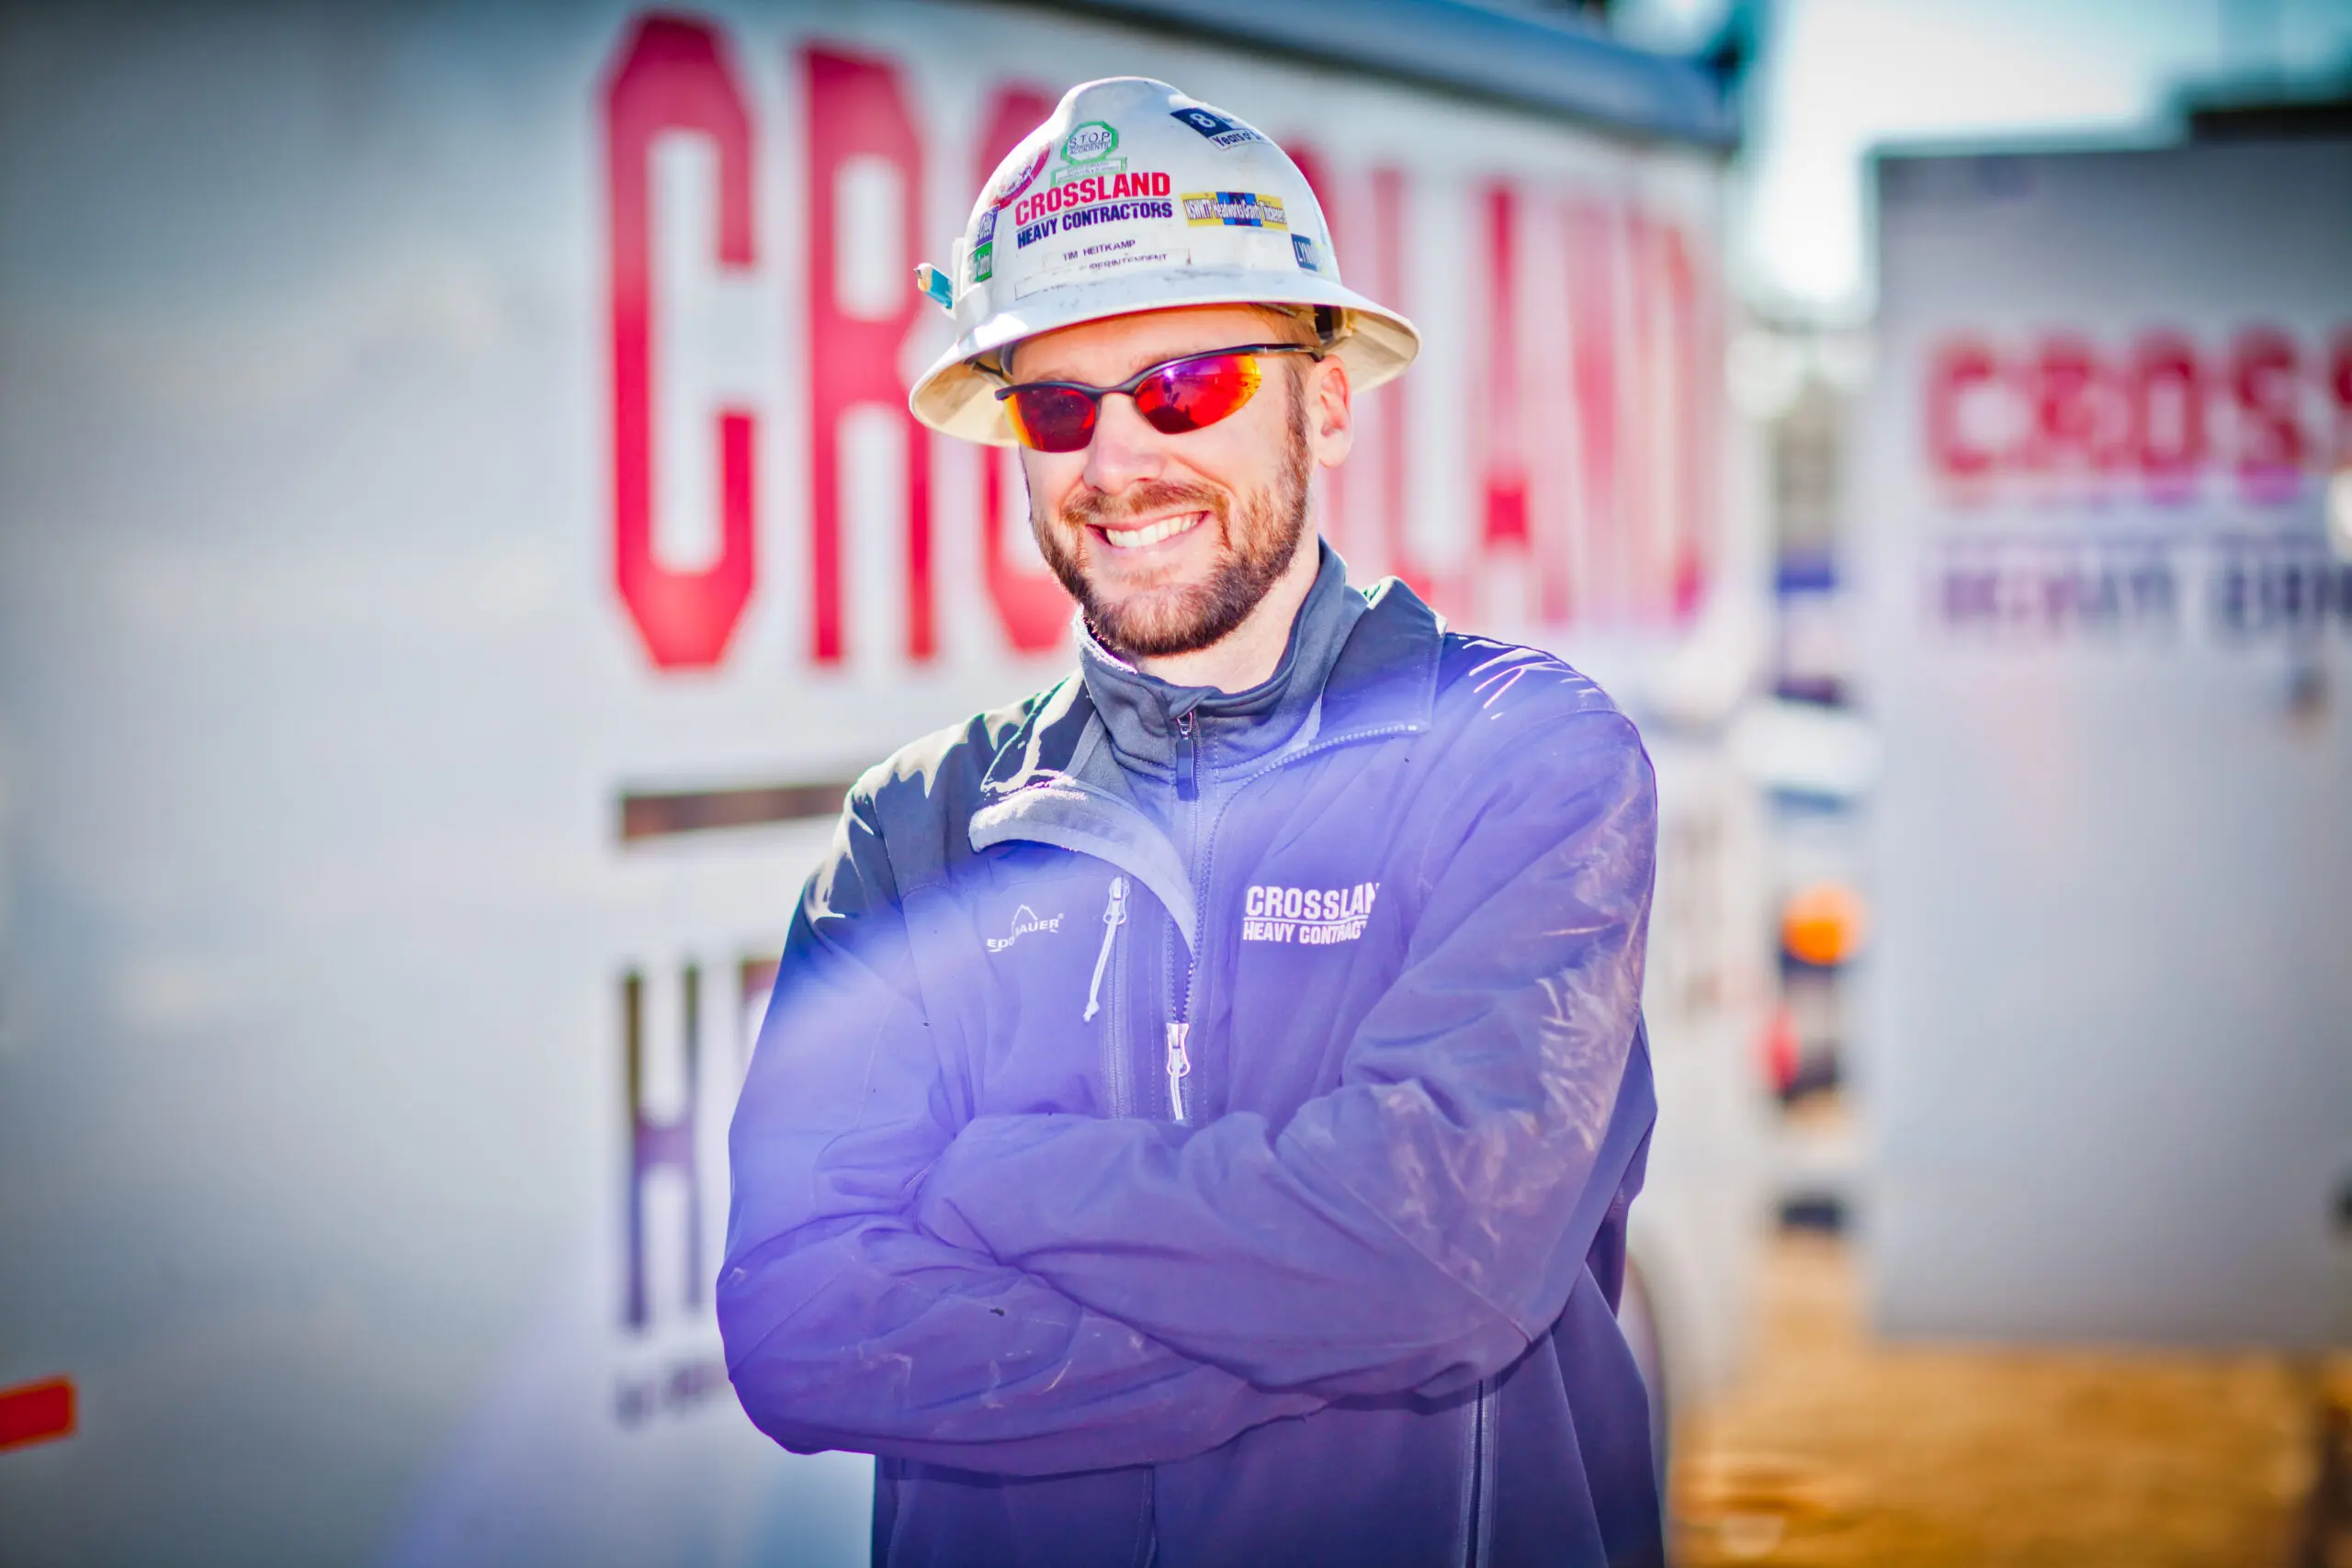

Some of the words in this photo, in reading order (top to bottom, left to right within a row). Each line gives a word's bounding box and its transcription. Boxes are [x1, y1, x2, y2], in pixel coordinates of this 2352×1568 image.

[1189, 113, 1216, 128] 8
[1212, 131, 1245, 147] Years
[1015, 172, 1170, 226] CROSSLAND
[1017, 218, 1058, 250] HEAVY
[1062, 201, 1173, 231] CONTRACTORS
[1063, 250, 1079, 262] TIM
[1083, 239, 1136, 256] HEITKAMP
[1079, 254, 1168, 271] PERINTENDENT
[599, 7, 1716, 675] CRLAND
[1246, 882, 1380, 920] CROSSLAN
[1243, 920, 1296, 942] HEAVY
[1299, 920, 1368, 944] CONTRAC
